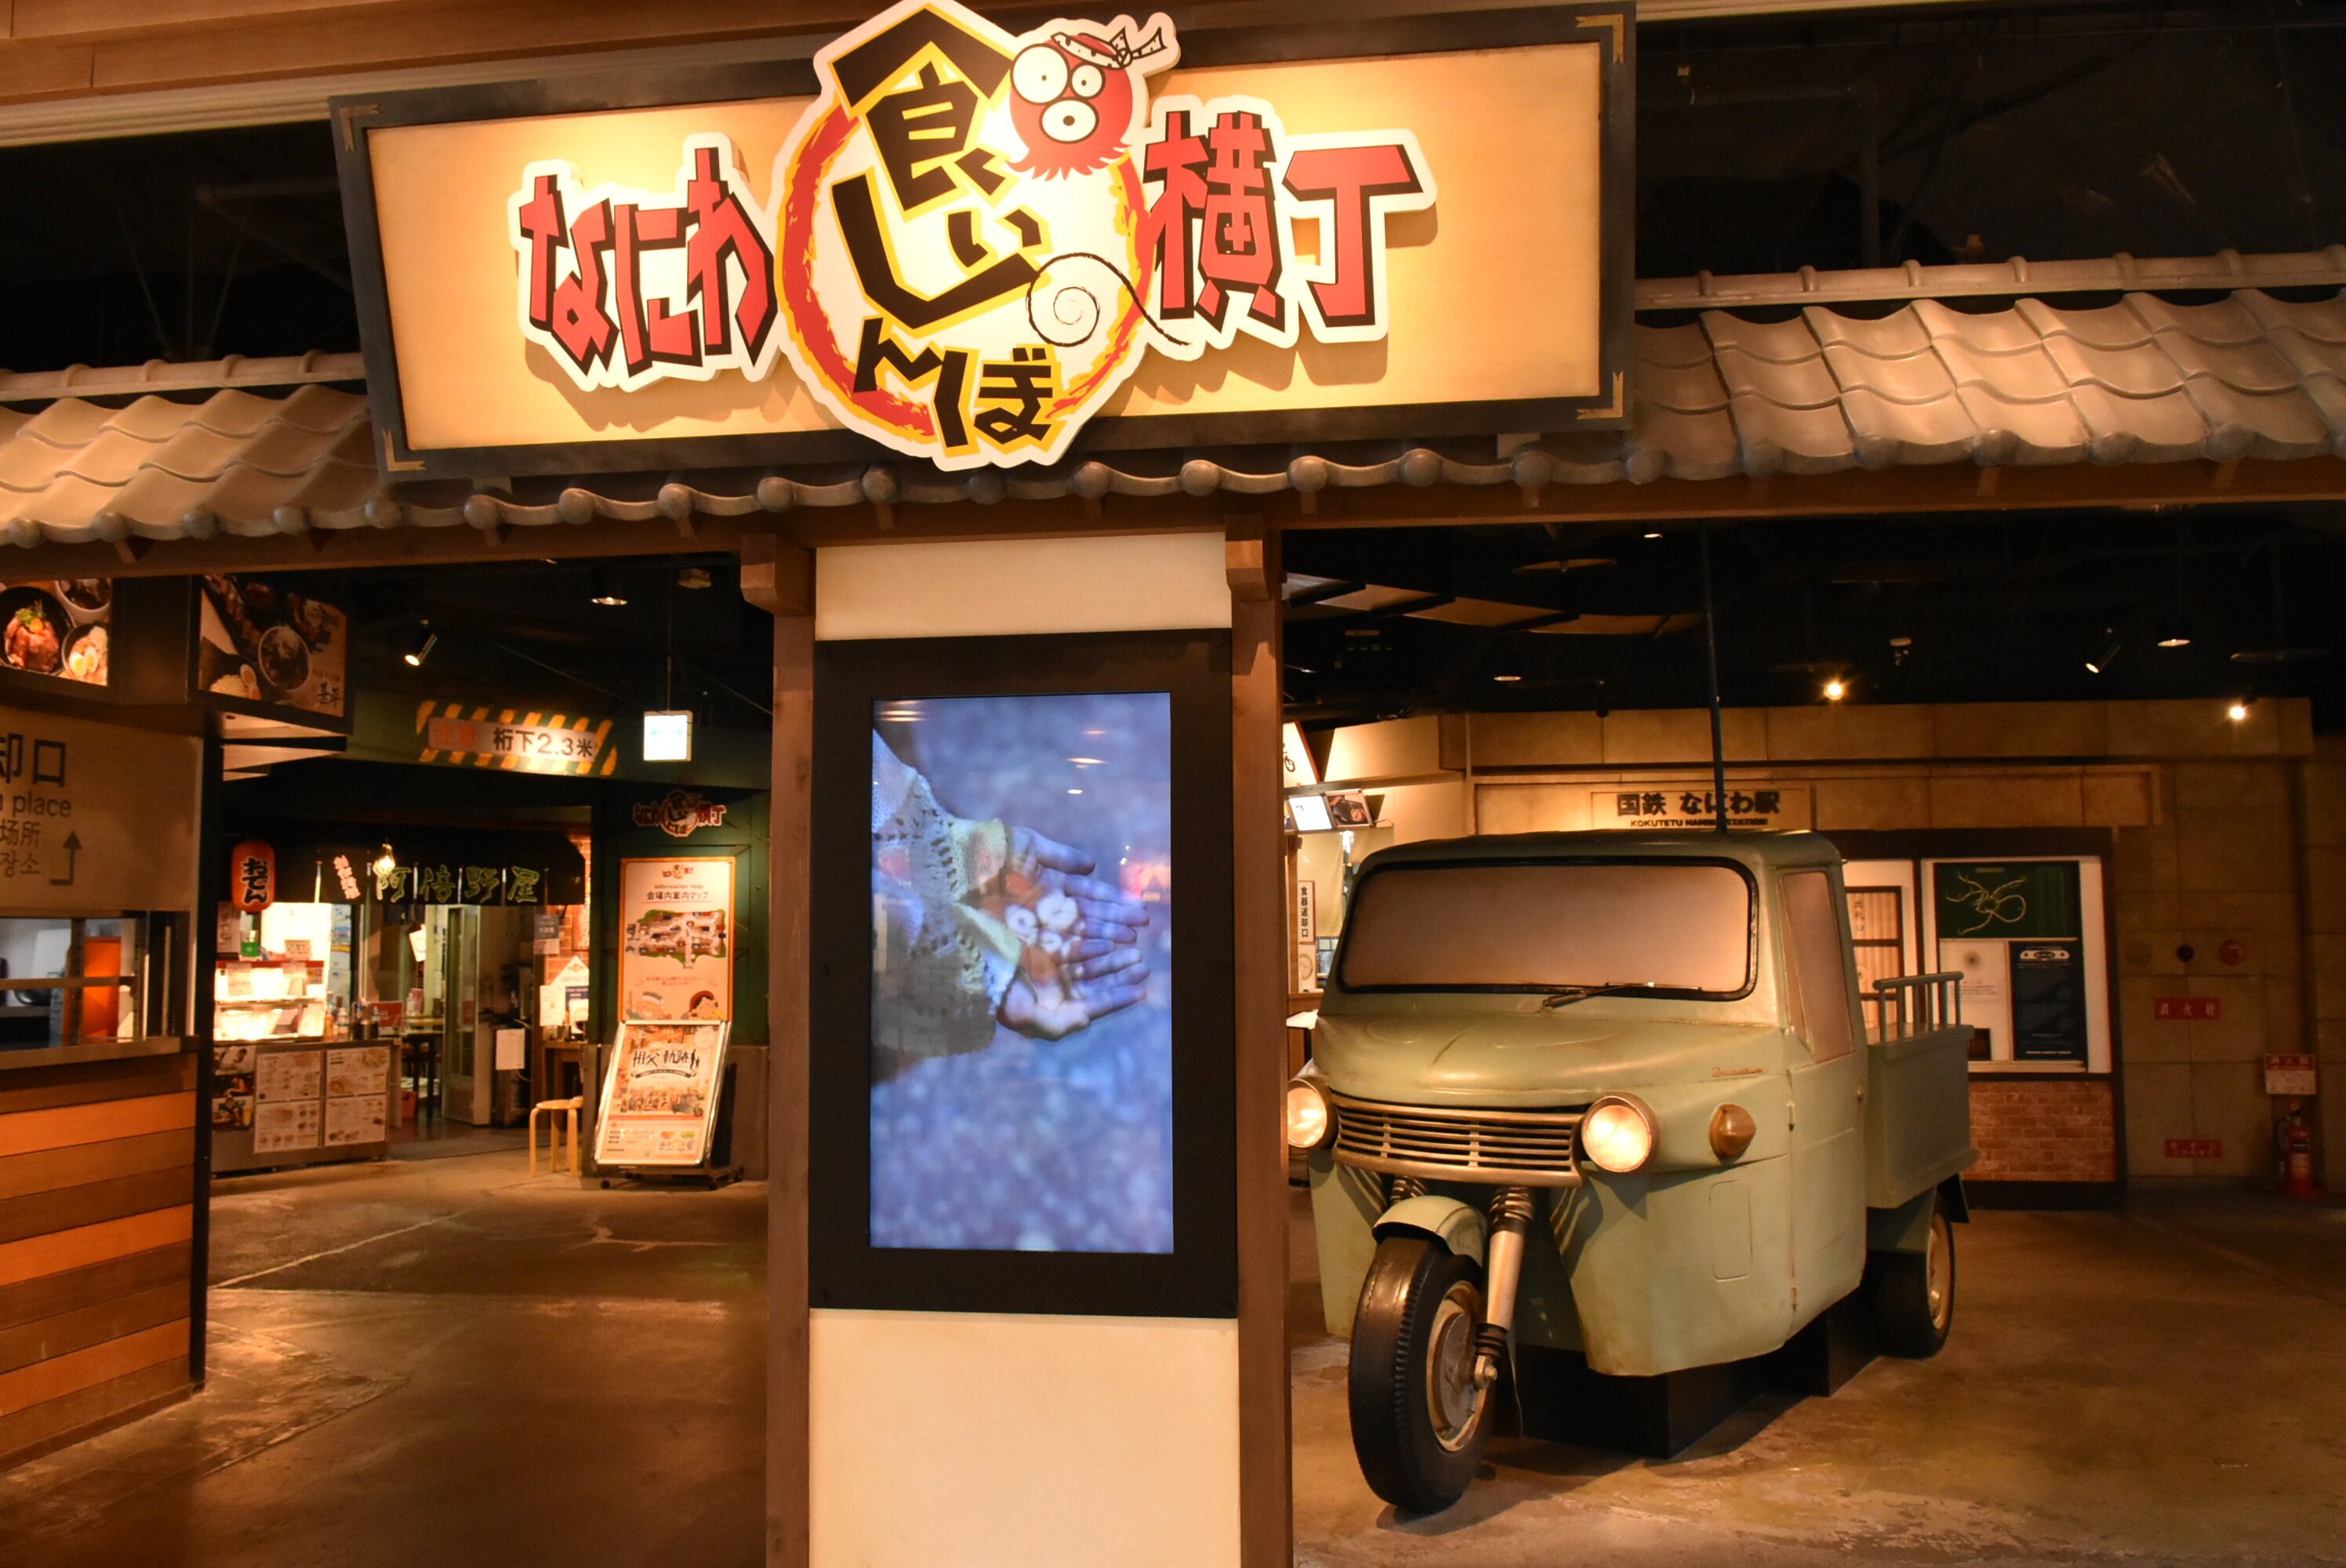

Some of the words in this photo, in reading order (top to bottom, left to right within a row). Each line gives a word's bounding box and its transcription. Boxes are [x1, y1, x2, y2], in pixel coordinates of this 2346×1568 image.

[518, 147, 779, 375] なにわ
[1143, 109, 1424, 331] 横丁
[492, 727, 596, 758] 桁下2.3米
[13, 791, 71, 818] place
[1617, 793, 1667, 816] 国鉄
[241, 856, 269, 906] おでん
[376, 864, 540, 904] 阿倍野屋
[647, 891, 709, 900] 会場内案内マップ
[1300, 886, 1309, 938] 食器返却口
